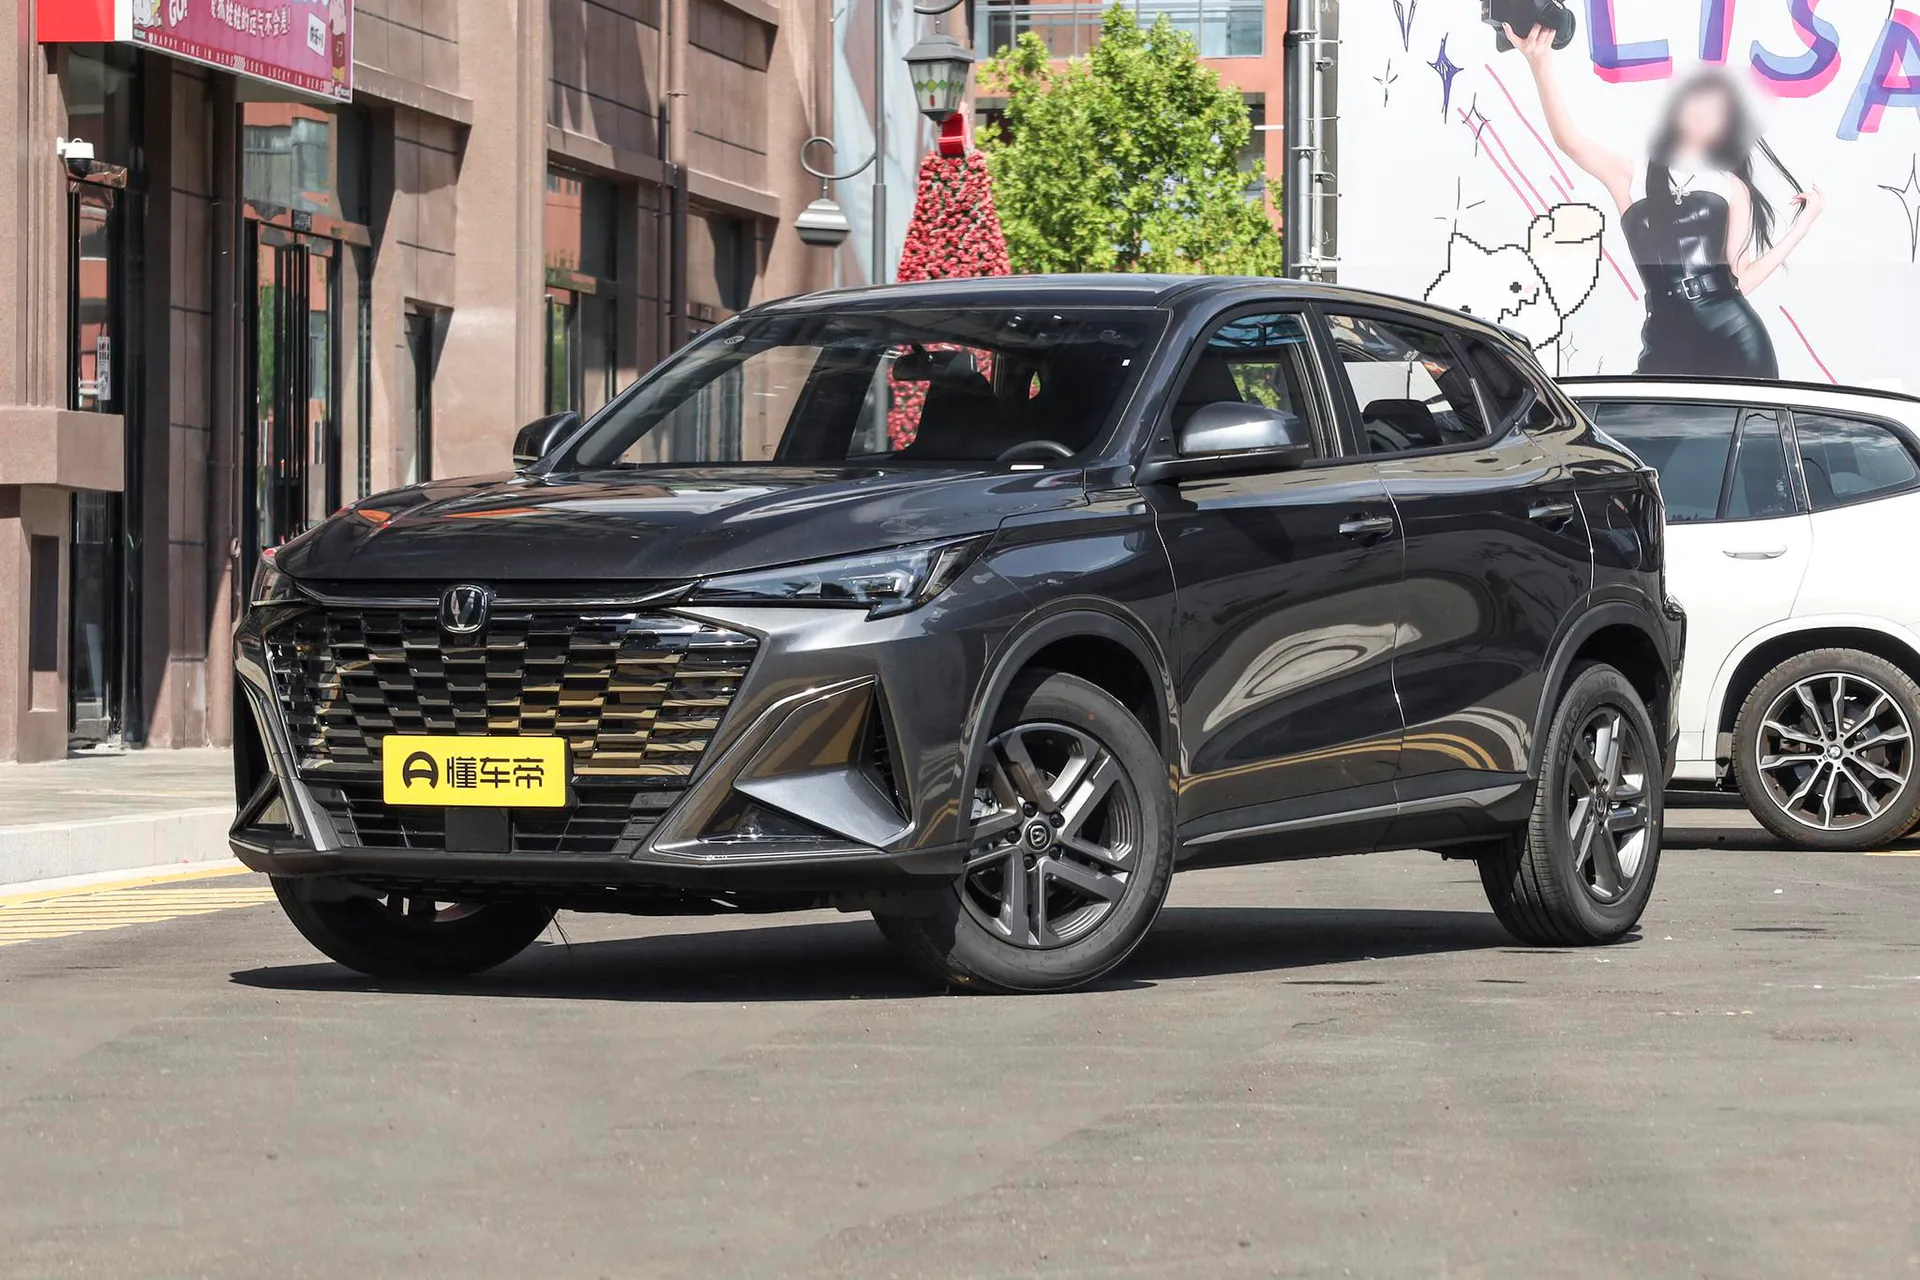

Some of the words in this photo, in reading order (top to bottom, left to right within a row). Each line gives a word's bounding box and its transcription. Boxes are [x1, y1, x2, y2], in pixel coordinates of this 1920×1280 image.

[153, 33, 178, 50] HAPPY
[182, 41, 200, 57] TIME
[204, 48, 212, 60] IN
[216, 52, 235, 67] HERE
[268, 65, 291, 82] LUCKY
[294, 73, 303, 86] IN
[306, 76, 323, 91] HERE
[1584, 0, 1920, 141] LISA
[446, 756, 544, 789] 懂车帝
